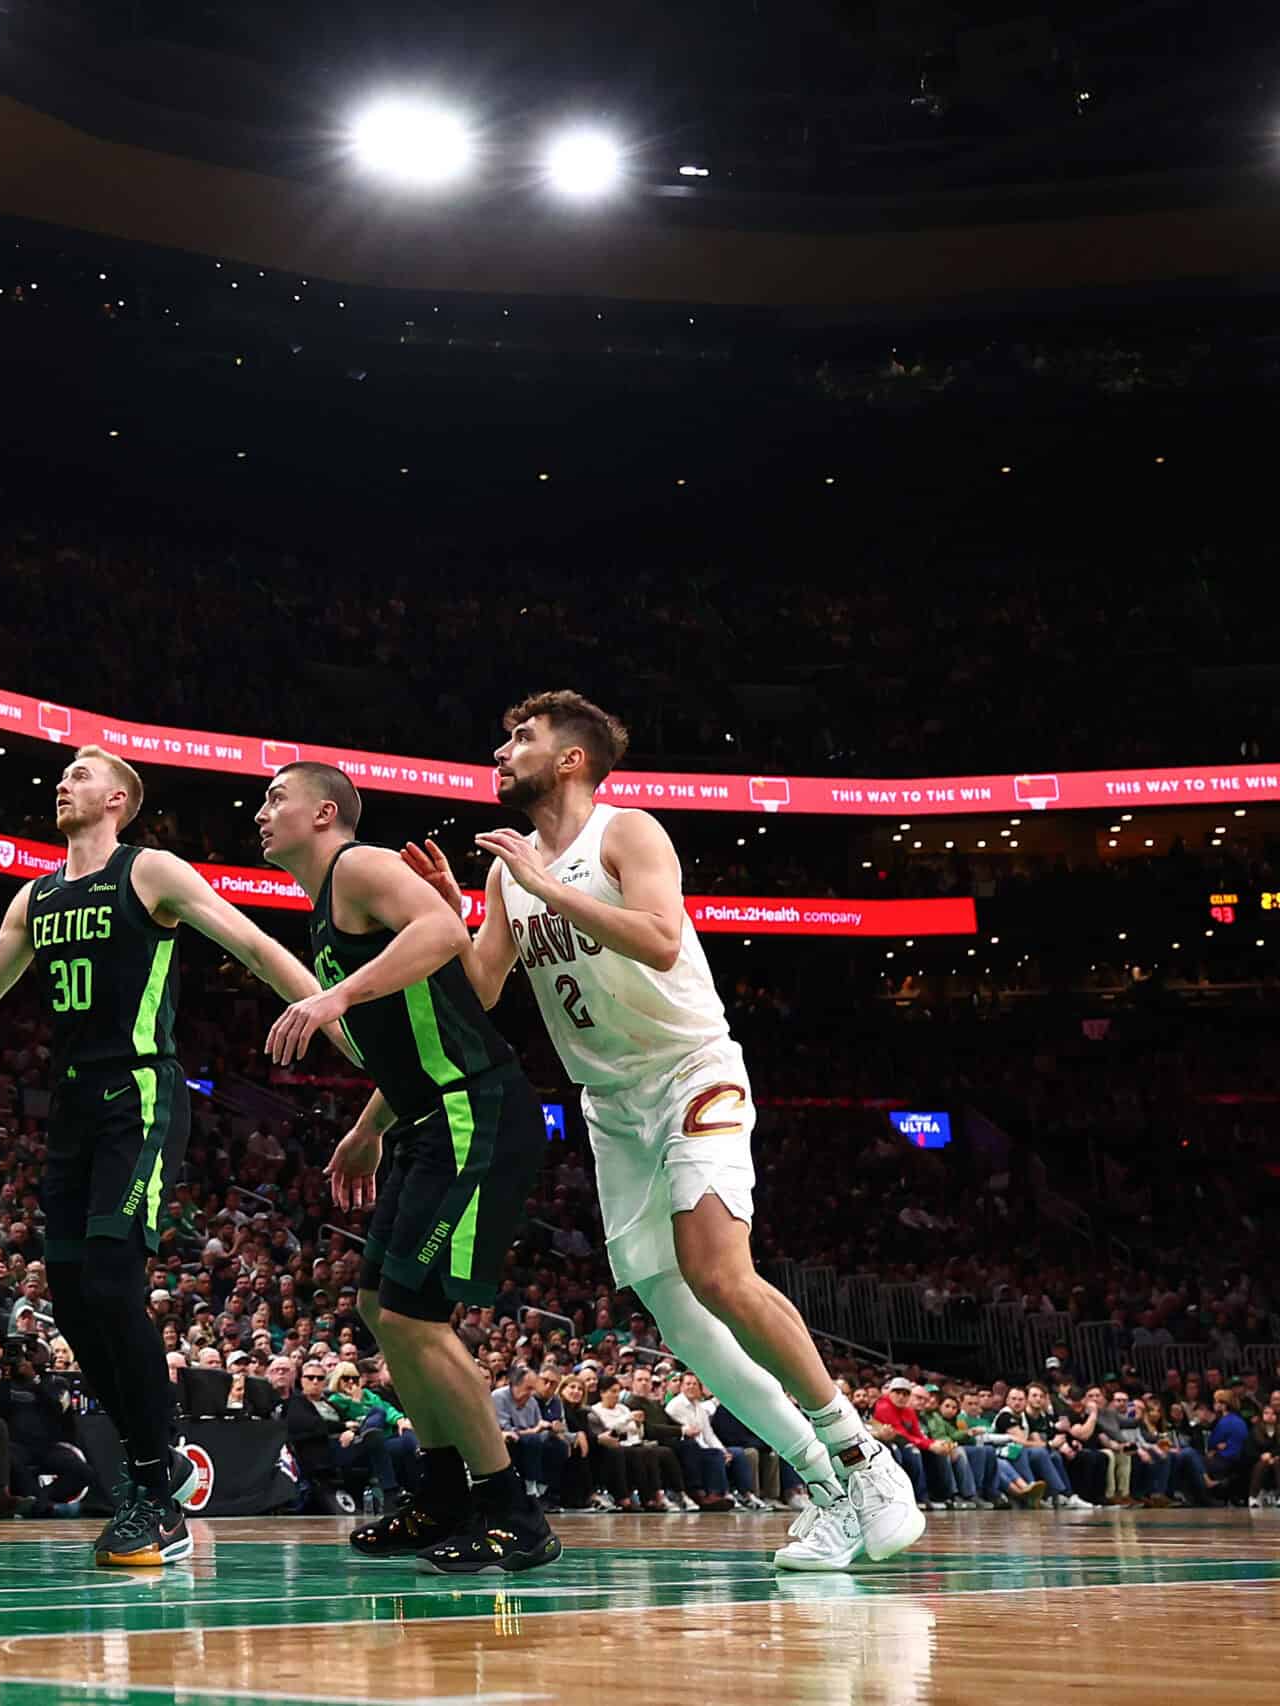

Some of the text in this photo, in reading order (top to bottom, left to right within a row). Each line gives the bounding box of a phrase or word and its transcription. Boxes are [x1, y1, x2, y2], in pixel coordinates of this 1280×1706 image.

[102, 729, 243, 760] THIS WAY TO THE WIN
[337, 761, 474, 788] THIS WAY TO THE WIN
[1105, 775, 1278, 794] THIS WAY TO THE WIN
[612, 784, 641, 795] WAY
[645, 784, 664, 796] TO
[669, 785, 695, 797] THE
[700, 786, 729, 798] WIN
[831, 787, 992, 803] THIS WAY TO THE WIN
[211, 879, 219, 888] a
[561, 871, 591, 885] CLIFFS
[33, 906, 112, 949] CELTICS
[695, 909, 702, 919] a
[803, 911, 862, 926] company
[50, 958, 92, 1012] 30
[555, 974, 595, 1028] 2
[900, 1120, 940, 1133] ULTRA
[122, 1178, 145, 1216] BOSTON
[417, 1220, 451, 1264] BOSTON
